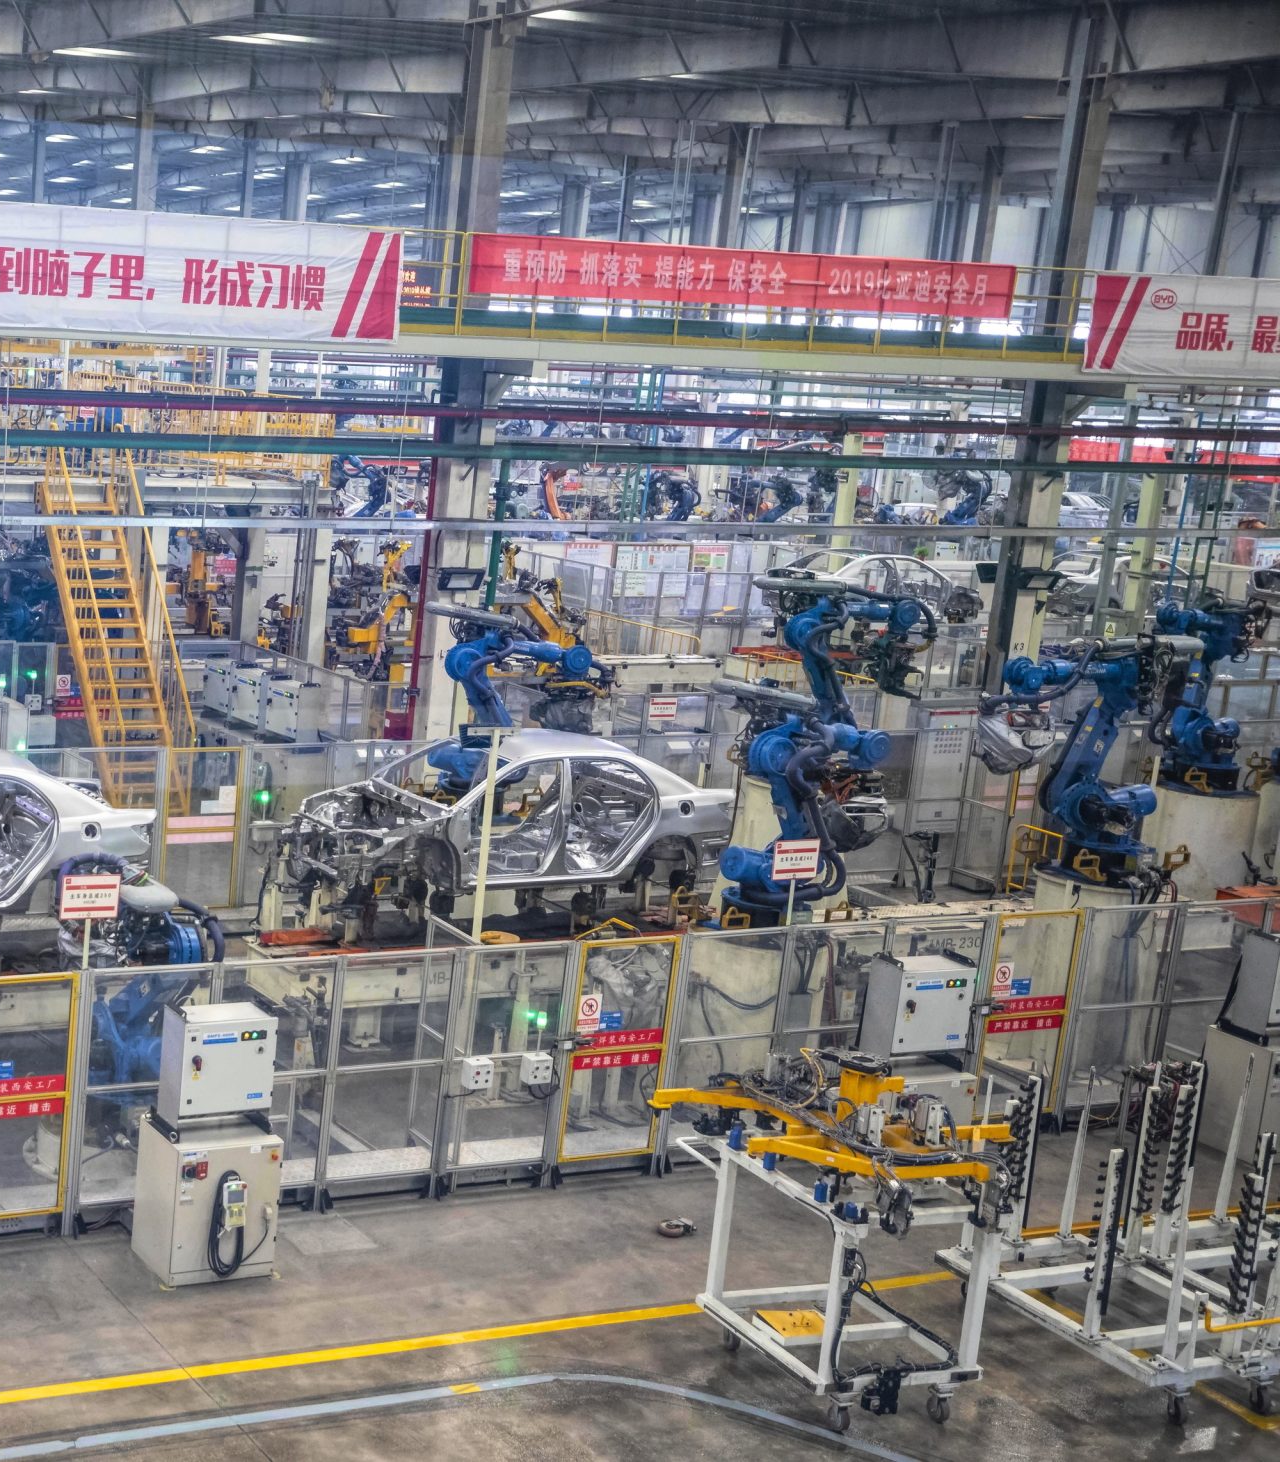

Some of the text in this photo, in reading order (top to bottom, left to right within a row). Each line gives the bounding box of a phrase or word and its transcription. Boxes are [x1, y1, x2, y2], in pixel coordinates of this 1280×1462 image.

[503, 249, 568, 284] 重预防
[580, 251, 642, 287] 抓落实
[654, 255, 715, 290] 提能力
[1153, 294, 1174, 305] BYD
[1176, 312, 1280, 353] 品质，最
